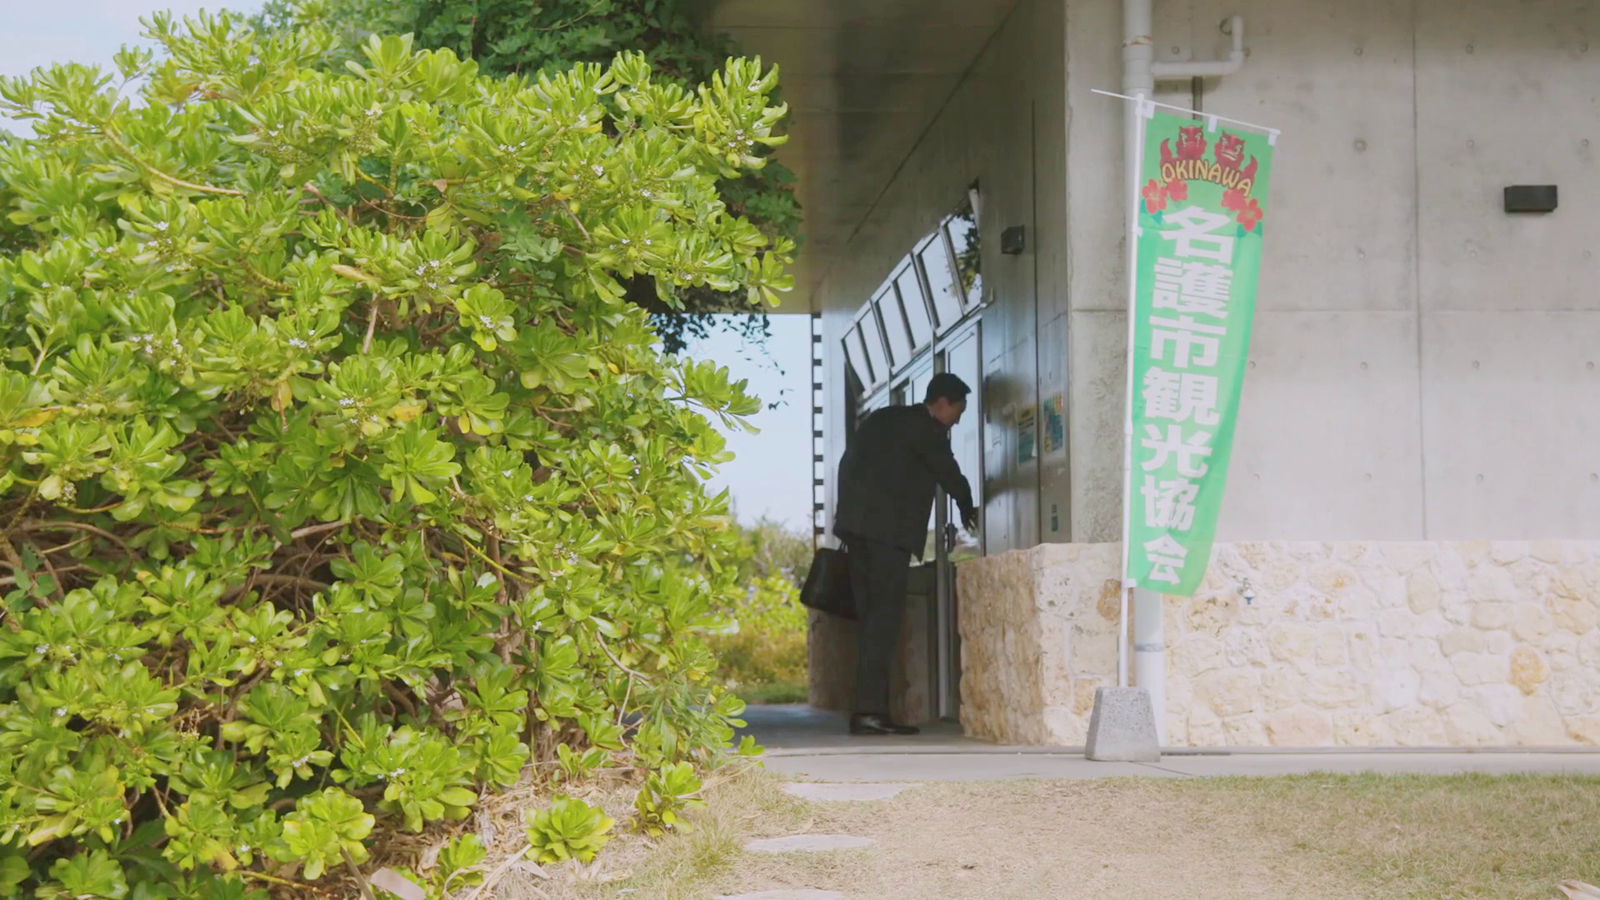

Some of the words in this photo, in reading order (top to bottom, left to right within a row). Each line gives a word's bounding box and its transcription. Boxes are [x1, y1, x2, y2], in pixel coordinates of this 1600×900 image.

[1161, 158, 1252, 198] OKINAWA
[1140, 205, 1234, 585] 名護市観光協会
